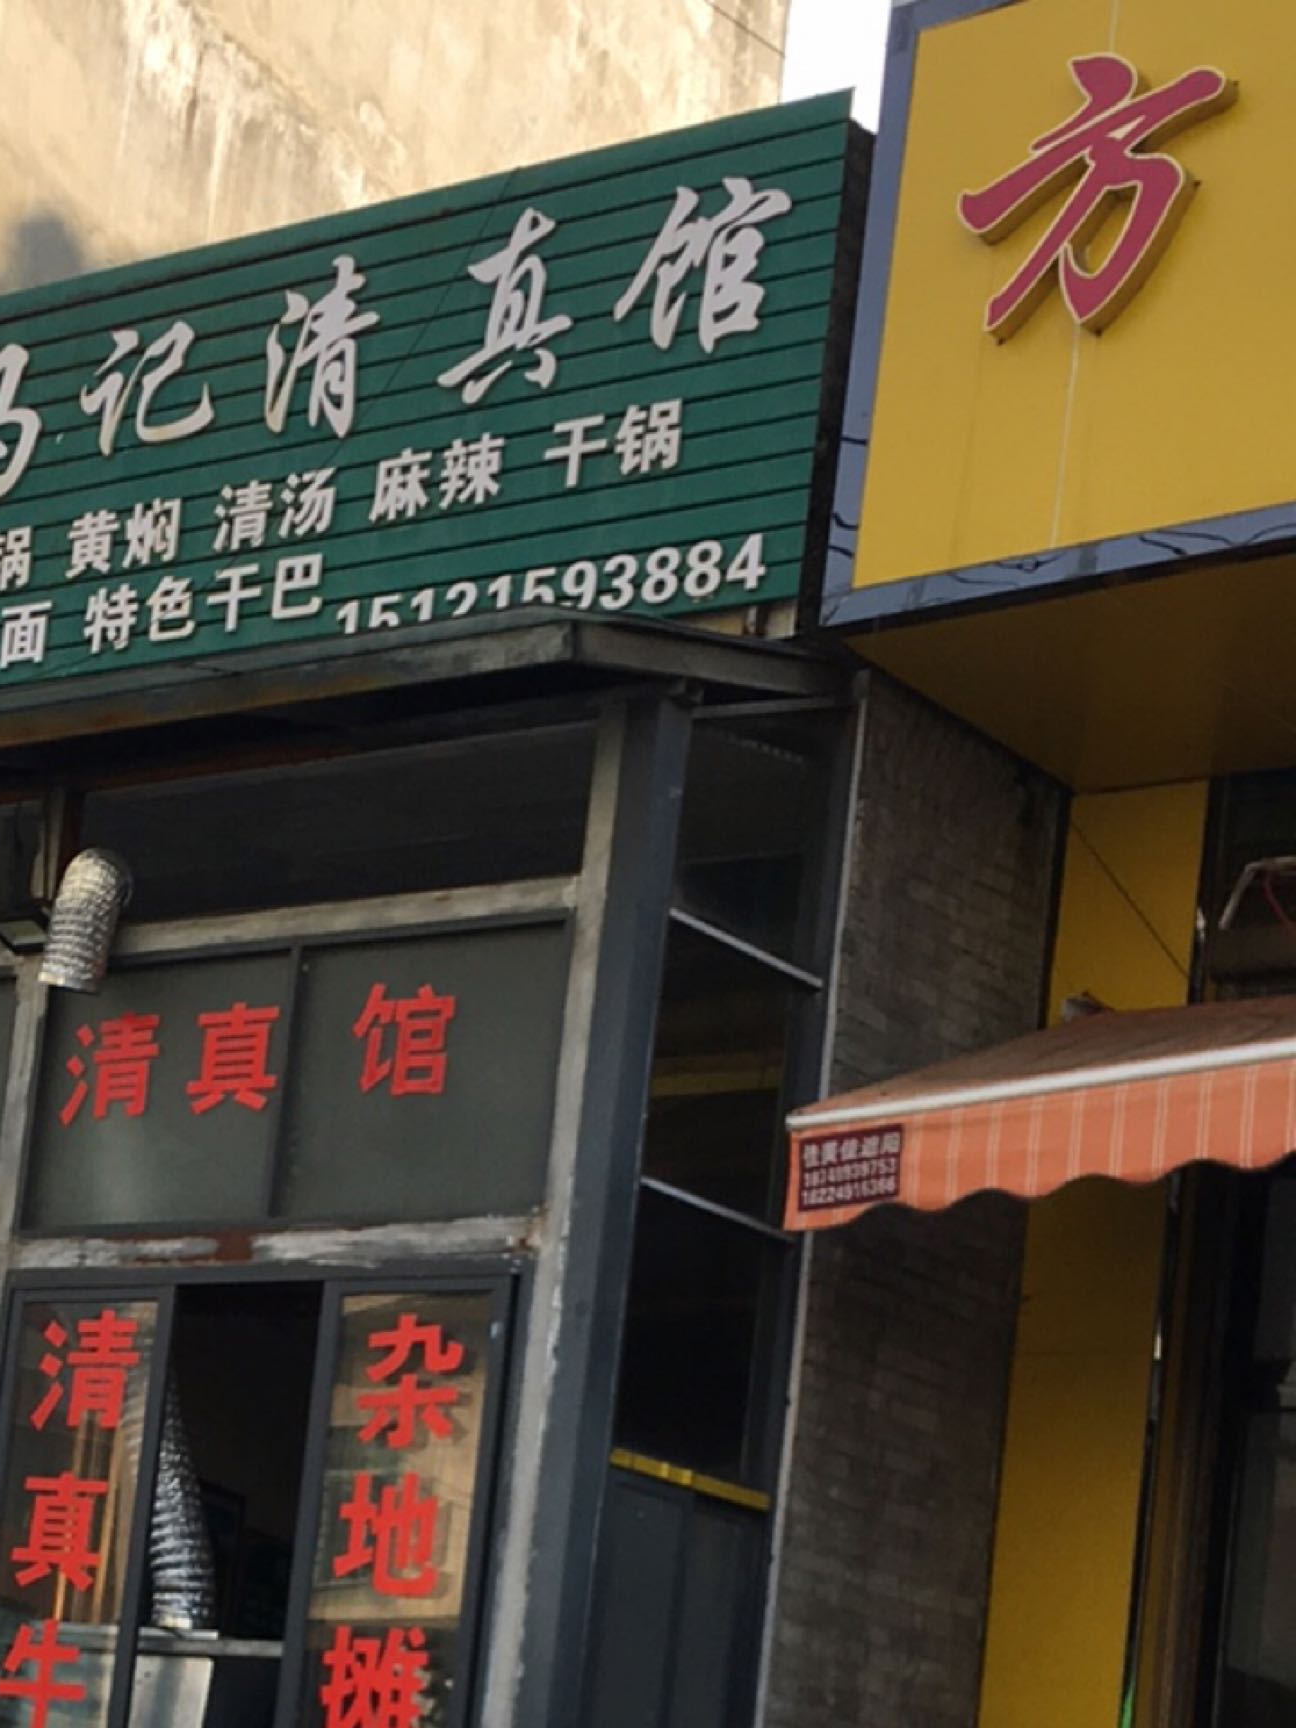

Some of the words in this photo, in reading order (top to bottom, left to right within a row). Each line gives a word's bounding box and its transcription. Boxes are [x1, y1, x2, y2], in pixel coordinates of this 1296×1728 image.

[958, 52, 1226, 332] 方
[66, 498, 182, 579] 黄焖
[212, 467, 336, 552] 清汤
[369, 433, 505, 523] 麻辣
[544, 398, 683, 488] 干锅
[83, 553, 324, 655] 特色干巴
